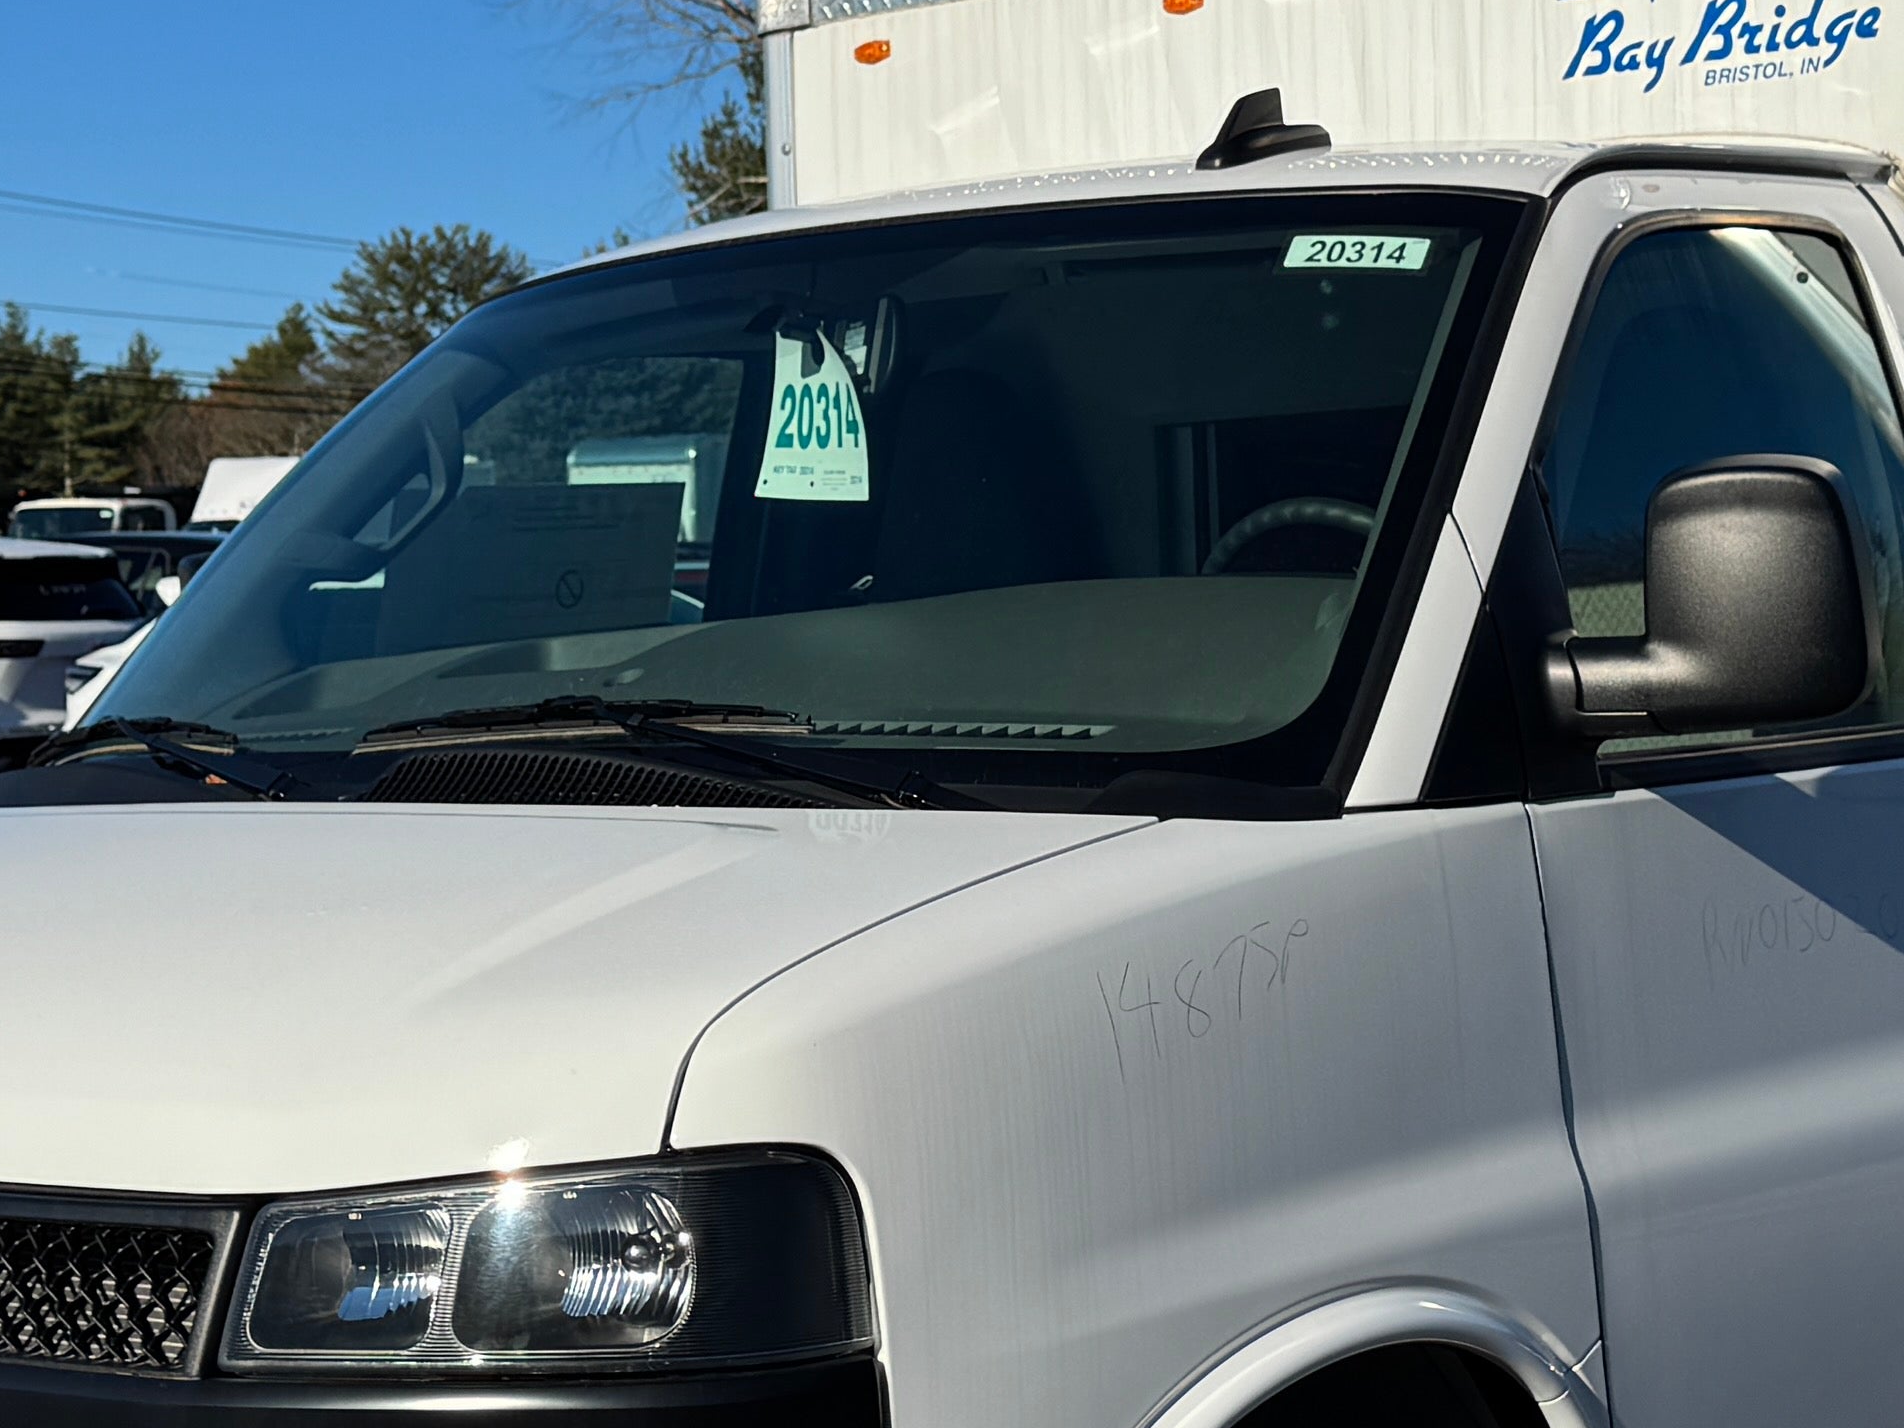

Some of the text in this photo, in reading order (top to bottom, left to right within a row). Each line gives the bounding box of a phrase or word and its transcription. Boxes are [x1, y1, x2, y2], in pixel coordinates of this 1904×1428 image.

[1562, 9, 1675, 94] Bay
[1704, 56, 1821, 87] BRISTOL, IN
[1304, 240, 1407, 264] 20314
[774, 380, 860, 450] 20314
